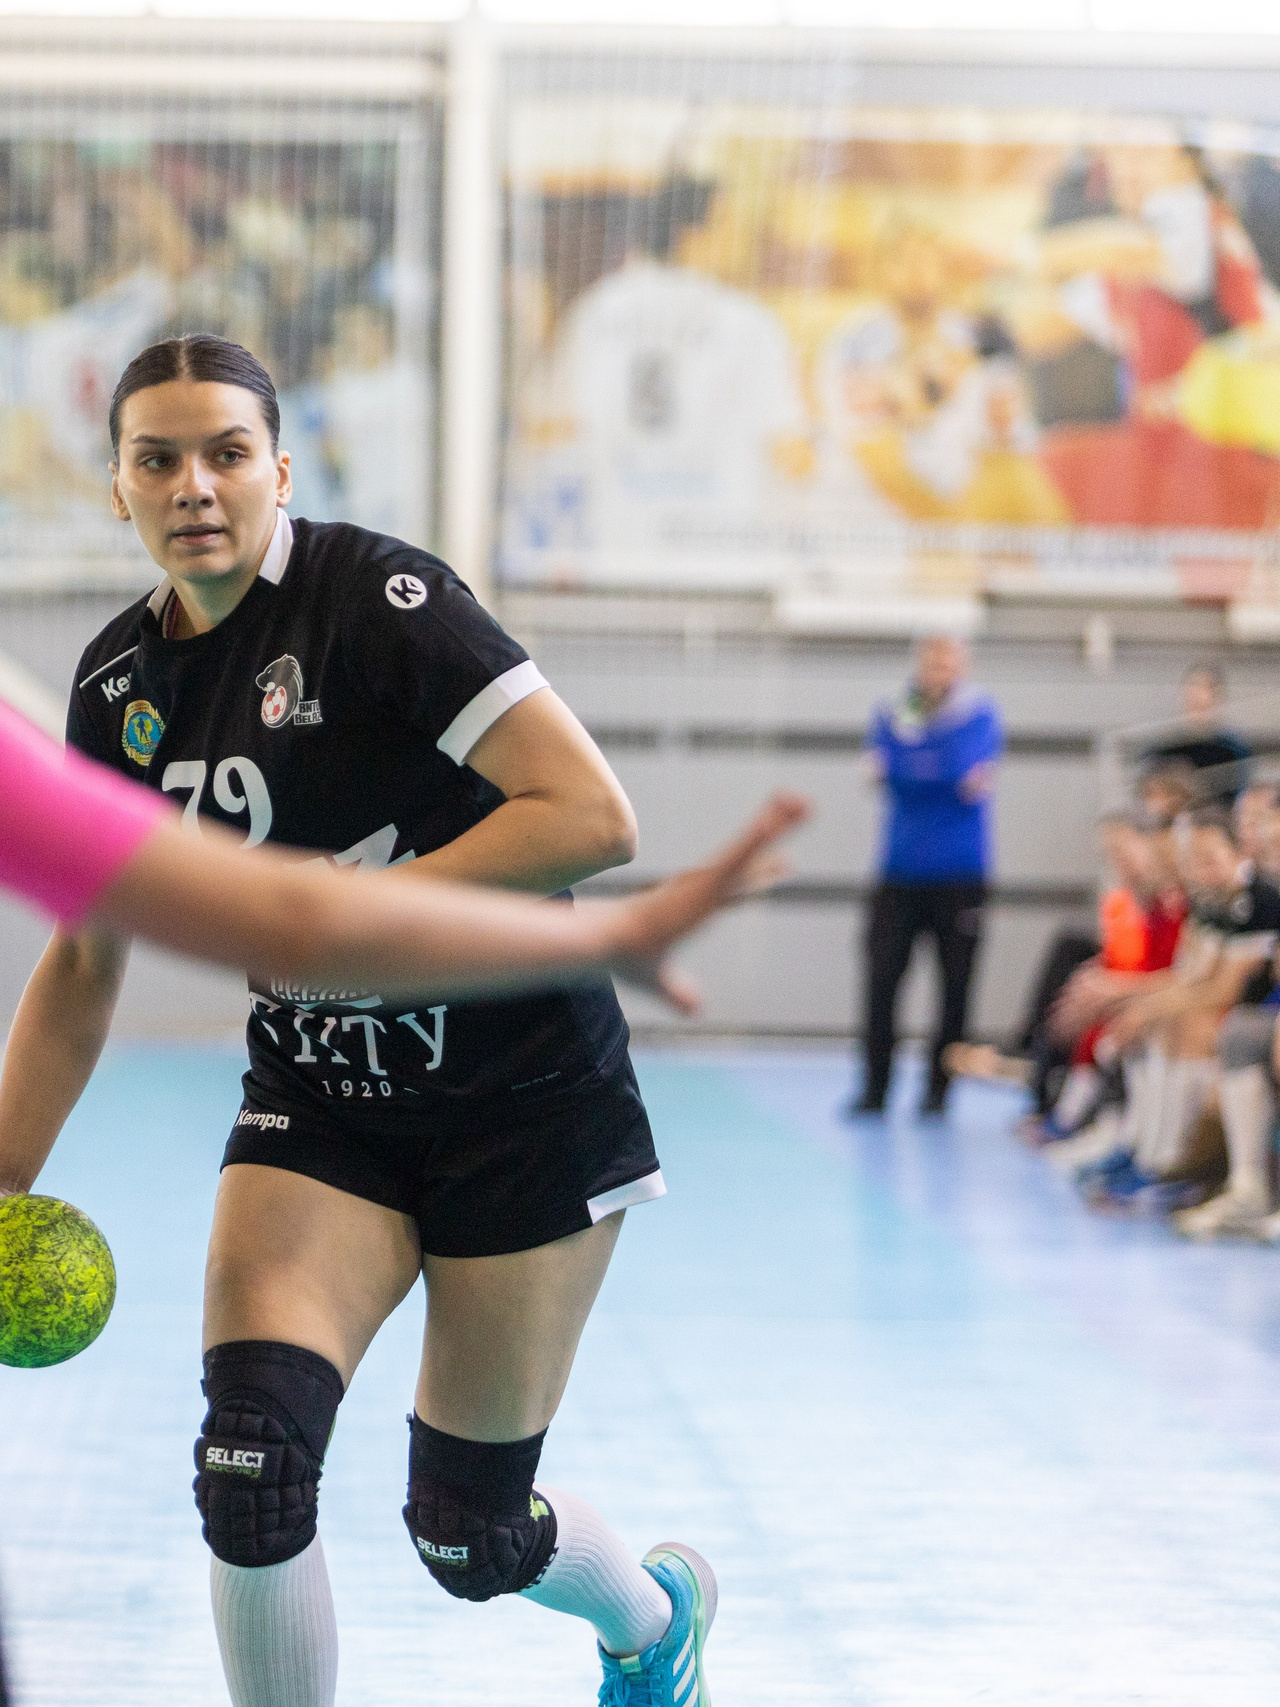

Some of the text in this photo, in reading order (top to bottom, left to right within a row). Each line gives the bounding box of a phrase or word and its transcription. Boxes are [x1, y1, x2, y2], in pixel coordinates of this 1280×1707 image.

[101, 673, 131, 702] Ke
[162, 756, 273, 850] 79
[322, 1080, 392, 1097] 1920
[235, 1109, 289, 1131] Kempa
[206, 1446, 265, 1469] SELECT
[417, 1536, 469, 1560] SELECT
